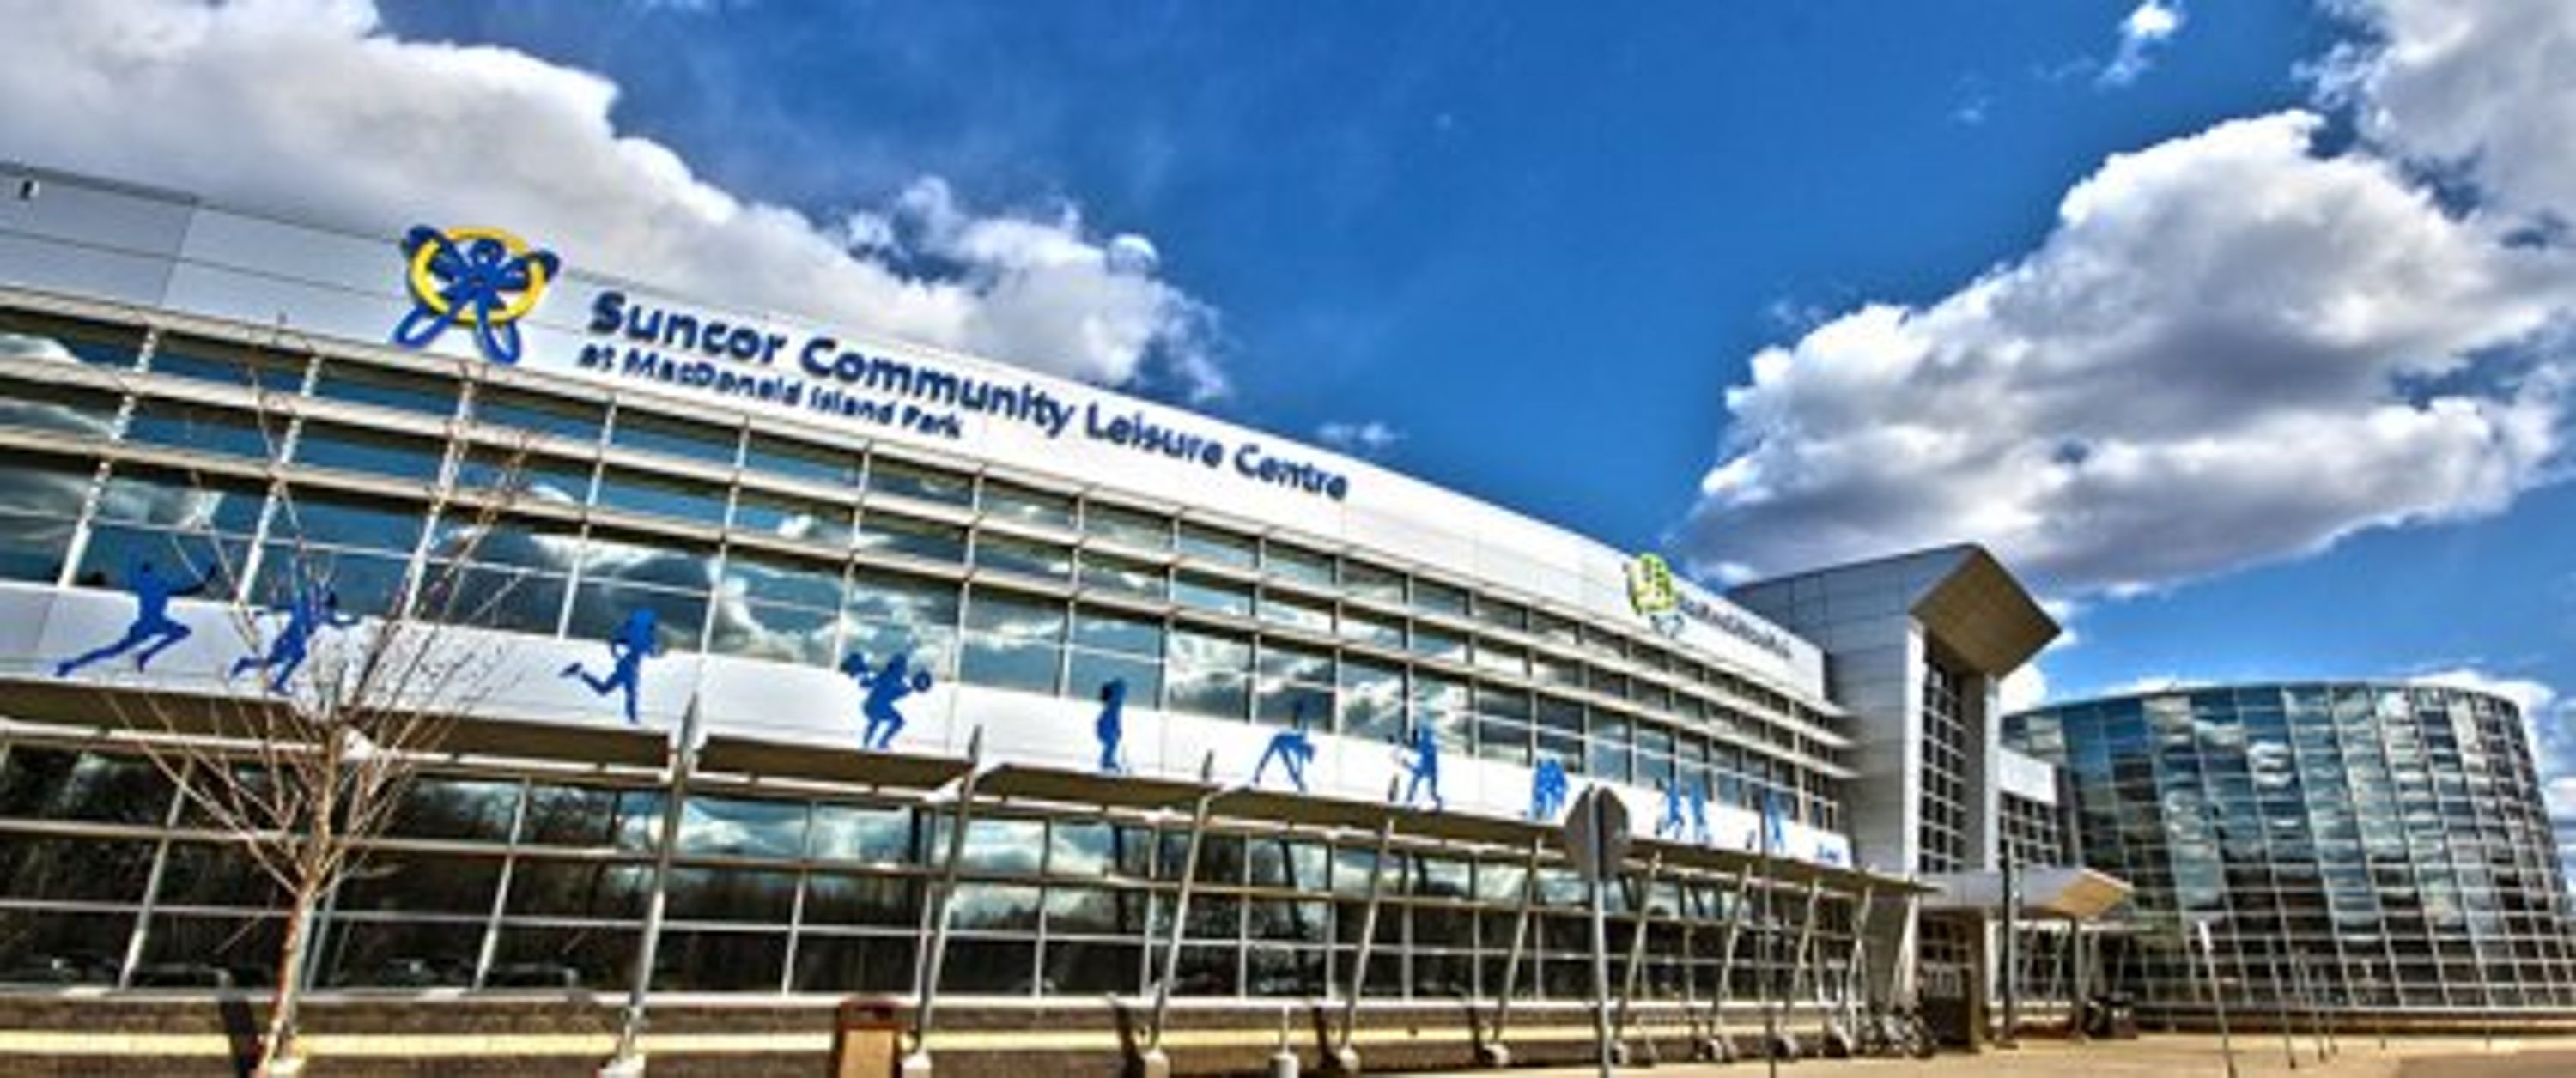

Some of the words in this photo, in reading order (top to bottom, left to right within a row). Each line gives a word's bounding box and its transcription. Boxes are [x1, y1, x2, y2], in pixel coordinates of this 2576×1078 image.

[578, 343, 616, 372] at
[622, 347, 803, 405] MacDonald
[810, 385, 896, 426] Island
[901, 404, 963, 439] Park
[590, 290, 788, 364] Suncor
[799, 337, 1076, 437] Community
[1085, 402, 1224, 469] Leisure
[1235, 442, 1348, 500] Centre
